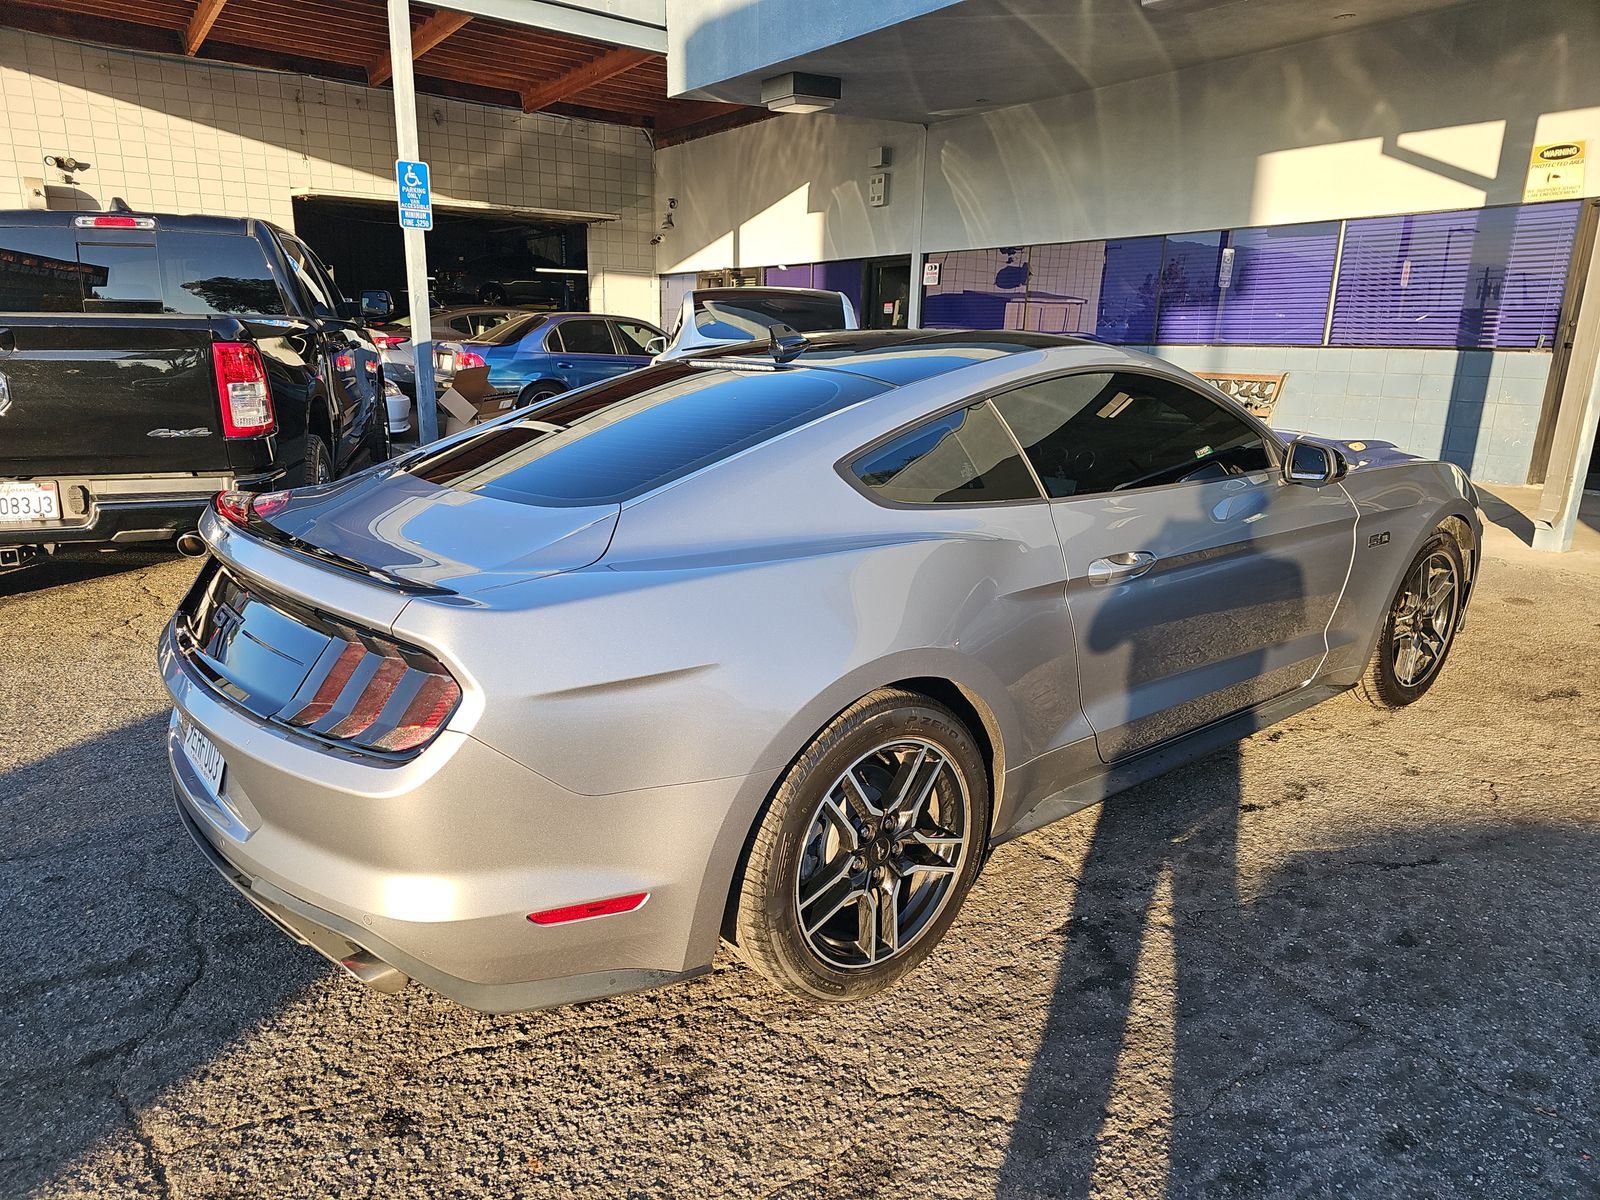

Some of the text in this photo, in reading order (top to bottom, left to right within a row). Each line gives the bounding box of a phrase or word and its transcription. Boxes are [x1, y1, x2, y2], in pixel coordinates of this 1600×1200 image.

[1543, 146, 1578, 158] WARNING
[1531, 160, 1568, 169] PROTECTED
[401, 186, 426, 195] PARKING
[406, 192, 422, 200] ONLY
[401, 202, 429, 210] ACCESSIBLE
[0, 496, 53, 515] 083J3
